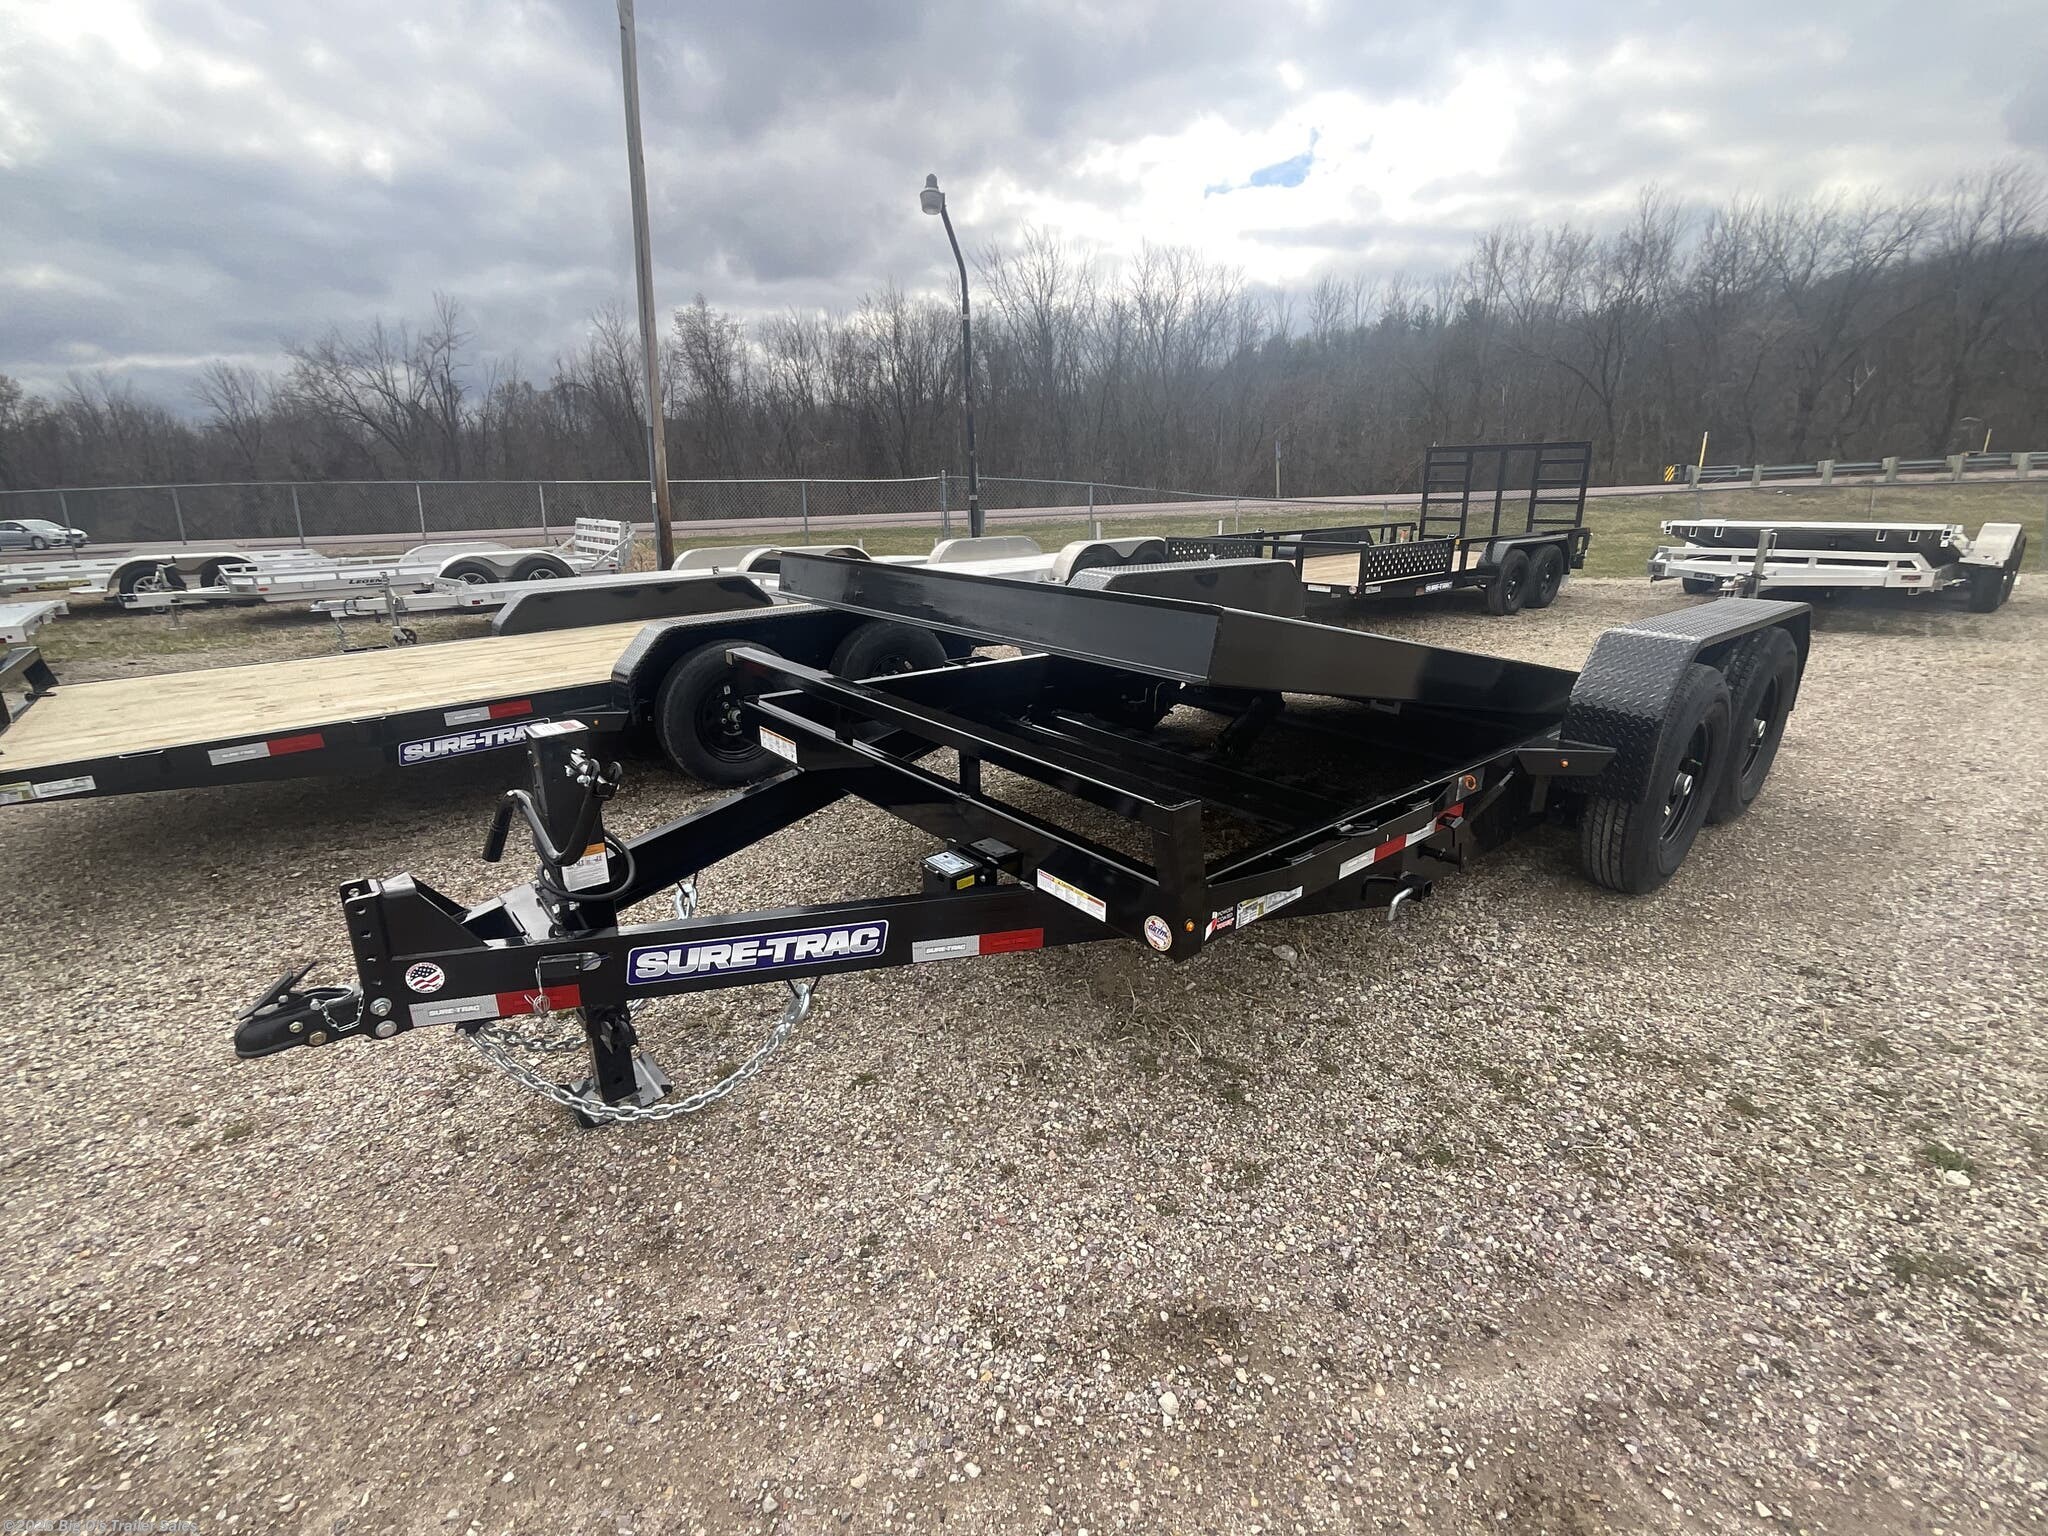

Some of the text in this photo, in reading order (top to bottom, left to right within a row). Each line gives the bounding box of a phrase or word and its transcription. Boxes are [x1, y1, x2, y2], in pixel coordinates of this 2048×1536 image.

[403, 723, 534, 762] SURE-TRA
[635, 927, 880, 978] SURE-TRAC
[428, 1004, 480, 1017] SURE-TRAC
